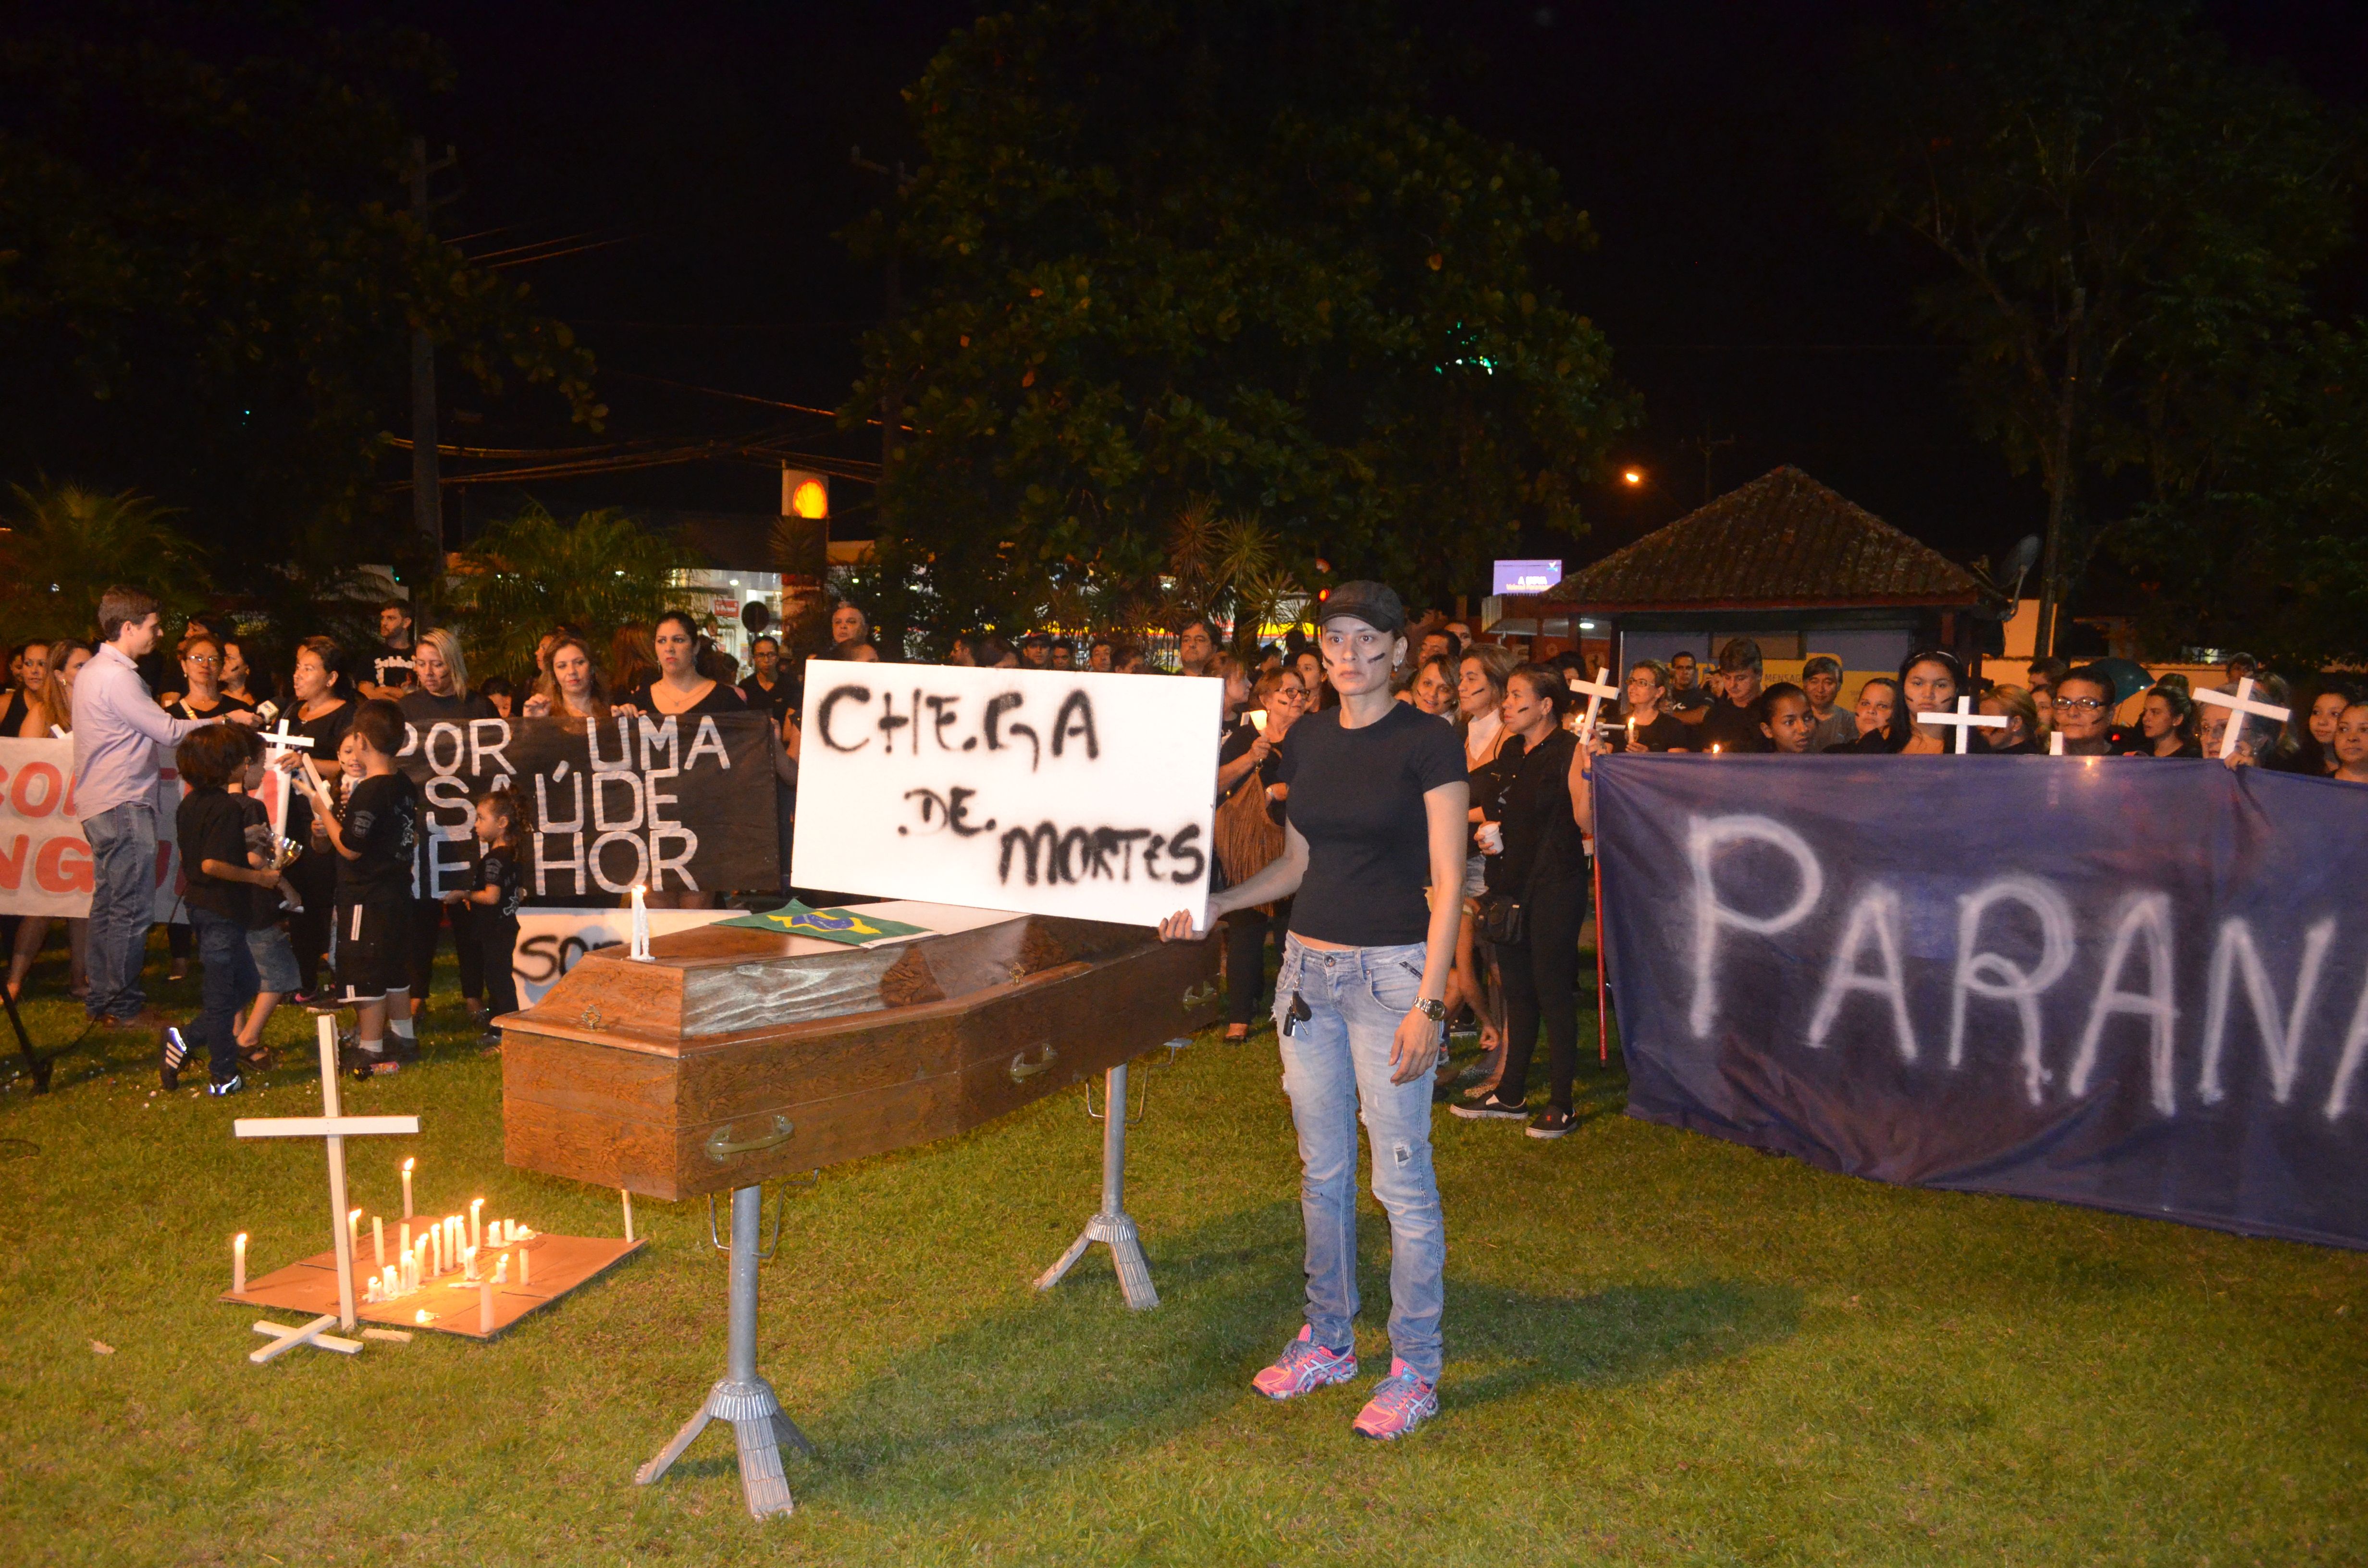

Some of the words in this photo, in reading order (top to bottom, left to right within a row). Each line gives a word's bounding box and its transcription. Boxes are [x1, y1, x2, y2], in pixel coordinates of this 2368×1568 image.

[1764, 674, 1803, 683] MENSAG
[586, 714, 731, 772] UMA
[817, 684, 1100, 772] CHEGA
[425, 760, 682, 834] SÚDE
[898, 786, 997, 837] DE
[411, 828, 700, 900] EHOR
[999, 820, 1206, 886] MORTES
[512, 934, 624, 982] SO
